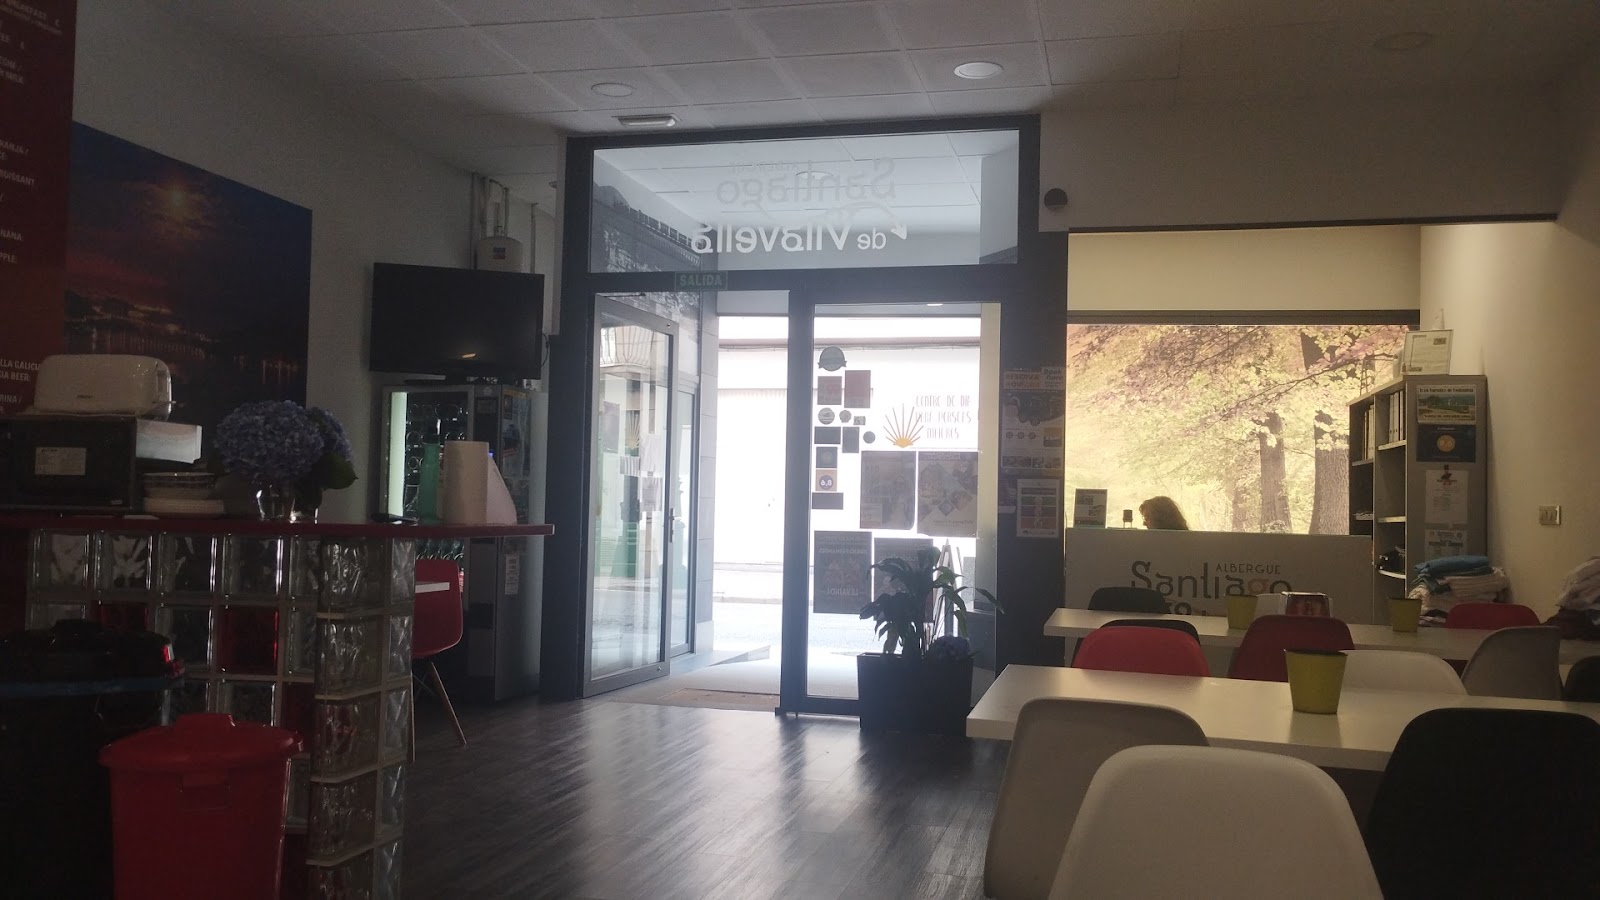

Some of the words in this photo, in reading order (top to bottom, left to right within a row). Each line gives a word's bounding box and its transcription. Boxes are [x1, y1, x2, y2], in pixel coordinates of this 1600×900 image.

[679, 274, 722, 287] SALIDA
[1215, 563, 1282, 575] ALBERGUE
[1131, 560, 1293, 599] Santiago
